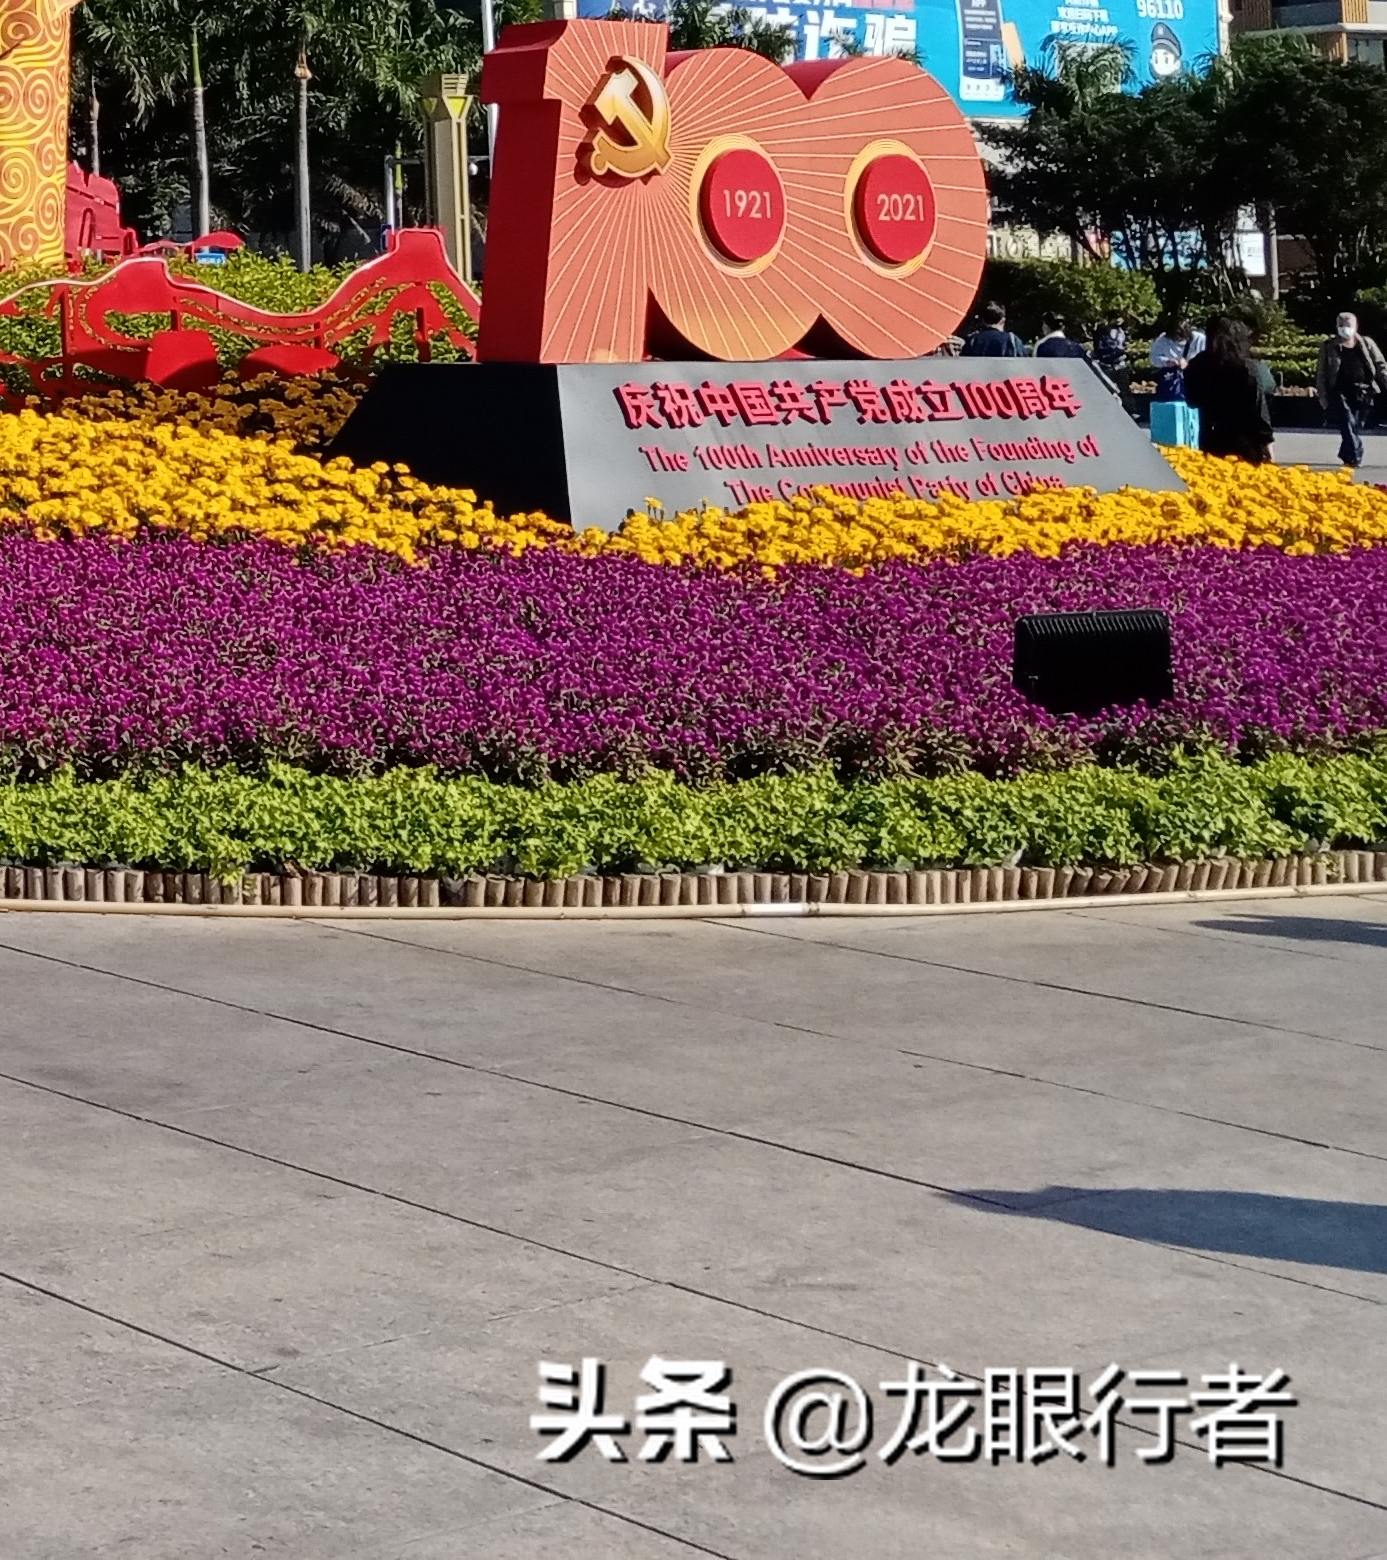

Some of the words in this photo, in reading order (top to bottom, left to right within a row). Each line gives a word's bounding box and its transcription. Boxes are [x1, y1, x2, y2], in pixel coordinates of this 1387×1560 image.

[722, 189, 772, 220] 1921
[876, 193, 925, 223] 2021
[614, 375, 1083, 430] 庆祝中国共产党成立100周年
[638, 445, 689, 473] The
[694, 441, 764, 470] 100th
[767, 439, 900, 472] Anniversary
[904, 437, 931, 465] of
[929, 436, 970, 464] the
[972, 436, 1075, 465] Founding
[1078, 433, 1102, 459] of
[724, 477, 776, 505] The
[907, 475, 971, 502] Party
[975, 471, 999, 496] of
